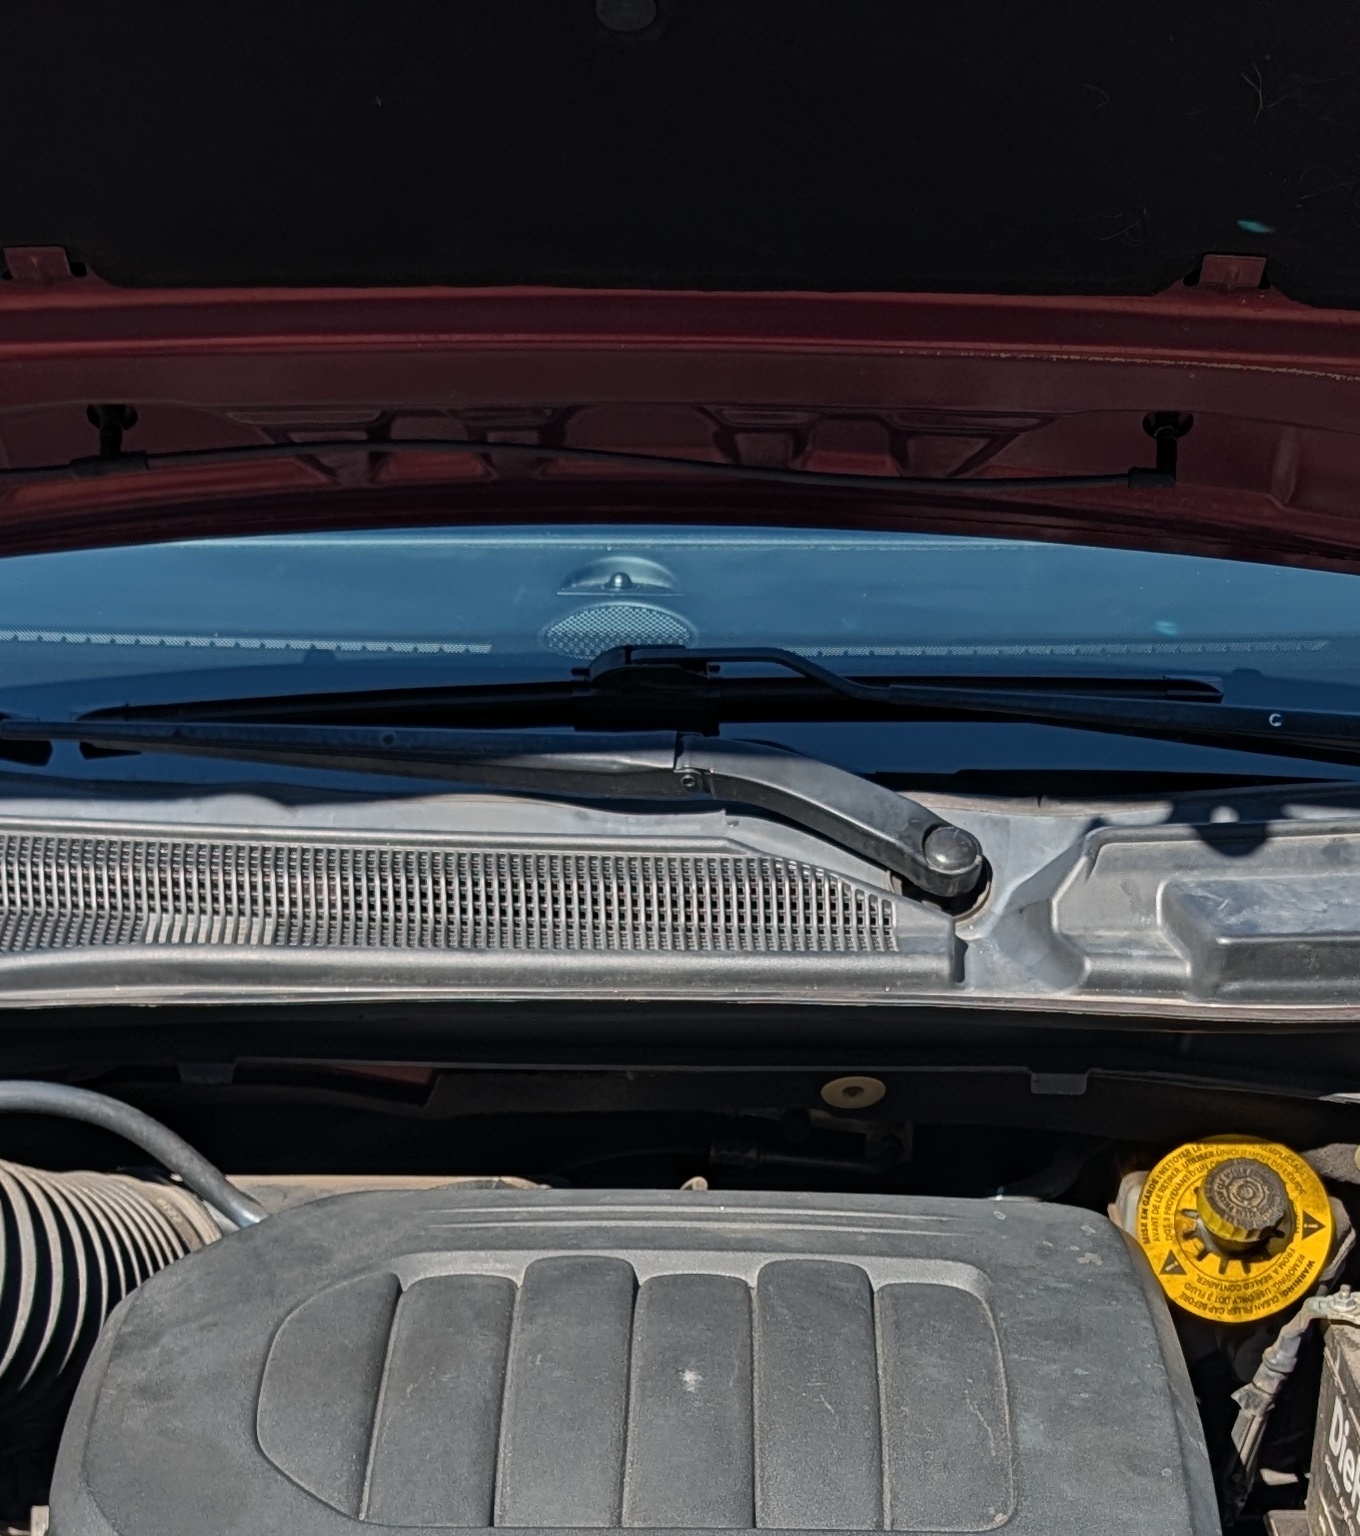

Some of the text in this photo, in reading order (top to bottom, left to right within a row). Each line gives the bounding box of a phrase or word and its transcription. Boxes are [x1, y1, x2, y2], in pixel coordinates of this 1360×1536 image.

[1184, 1151, 1215, 1168] UTILISER
[1141, 1207, 1149, 1219] EN
[1161, 1150, 1192, 1175] NETTOYER
[1155, 1195, 1162, 1203] LE
[1165, 1175, 1191, 1216] PROVENANT
[1152, 1204, 1160, 1216] DE
[1151, 1218, 1160, 1242] AVANT
[1164, 1226, 1173, 1241] DOT
[1278, 1248, 1295, 1268] FROM
[1184, 1282, 1207, 1299] FLUID
[1243, 1273, 1272, 1291] SEALED
[1178, 1291, 1207, 1312] BEFORE
[1214, 1295, 1230, 1304] DOT
[1232, 1294, 1254, 1304] ONLY
[1254, 1288, 1271, 1299] USE
[1207, 1305, 1225, 1315] CAP
[1227, 1305, 1252, 1315] FILLER
[1252, 1294, 1279, 1311] CLEAN
